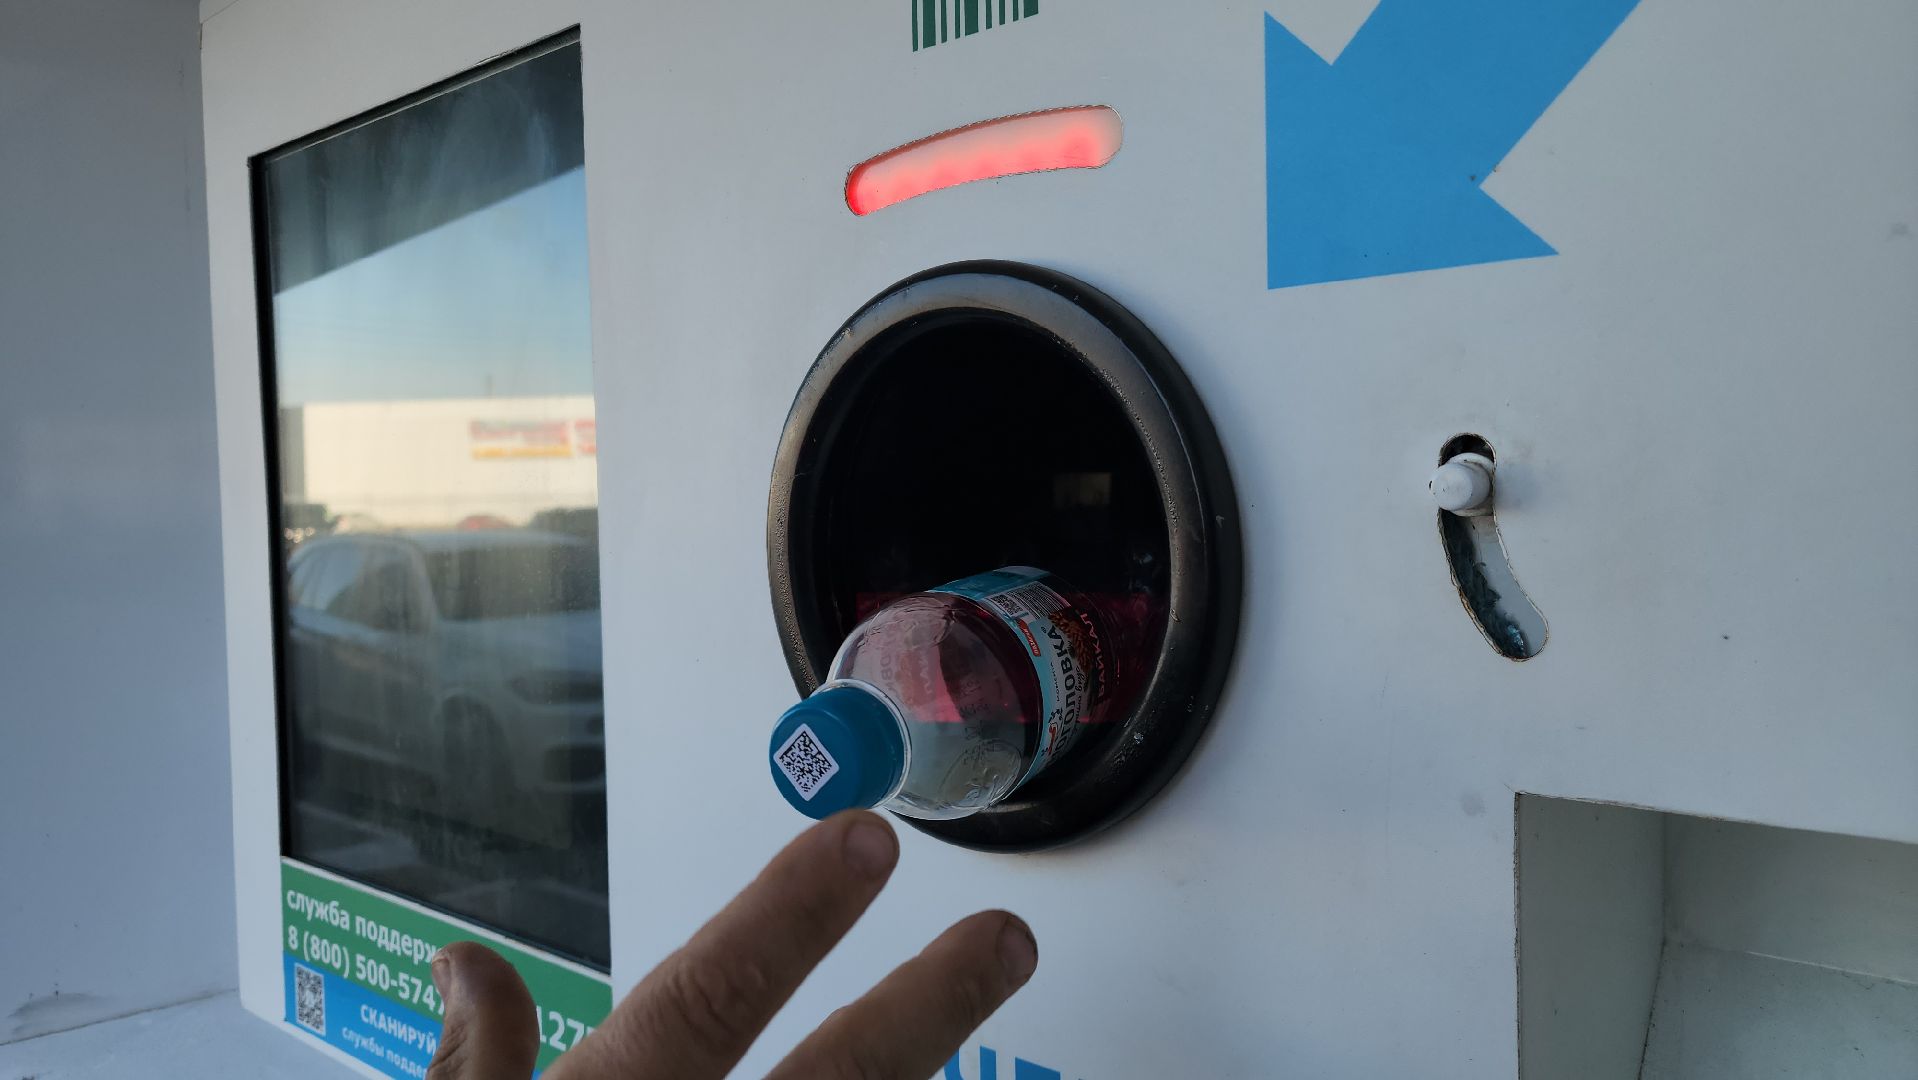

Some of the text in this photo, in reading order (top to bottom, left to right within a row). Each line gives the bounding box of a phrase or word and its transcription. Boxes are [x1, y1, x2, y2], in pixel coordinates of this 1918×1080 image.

[1047, 625, 1077, 757] ОГОЛОВКА
[287, 890, 350, 931] служба
[288, 925, 298, 950] 8
[303, 931, 350, 979] (800)
[341, 1027, 385, 1058] службы
[360, 1004, 437, 1057] СКАНИРУЙ
[535, 1004, 599, 1052] 127
